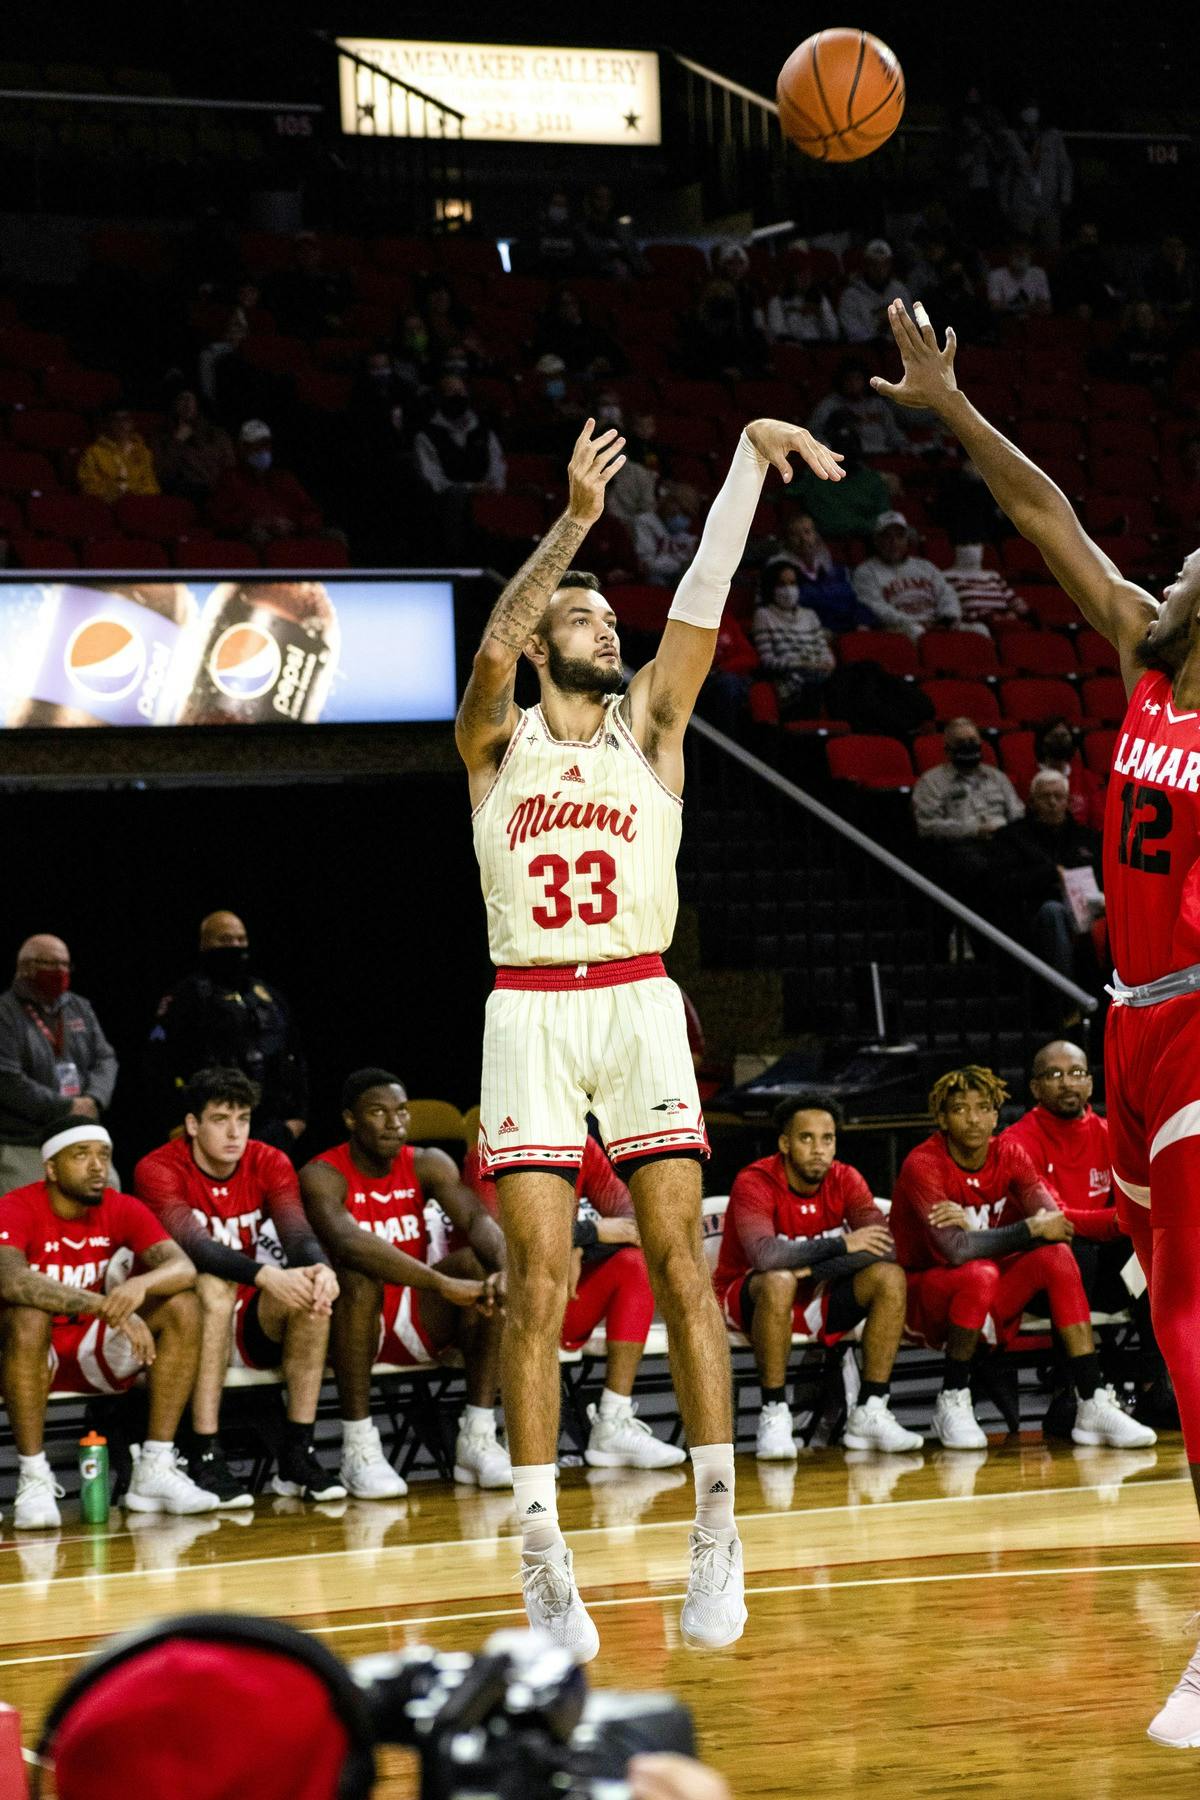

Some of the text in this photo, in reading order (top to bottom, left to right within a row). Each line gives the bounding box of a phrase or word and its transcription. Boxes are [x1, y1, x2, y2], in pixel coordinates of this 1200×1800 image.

[532, 55, 642, 86] GALLERY
[273, 643, 306, 717] pepsi
[1114, 732, 1200, 793] LAMAR
[506, 791, 638, 851] Miami
[1118, 781, 1174, 876] 12
[528, 850, 618, 930] 33
